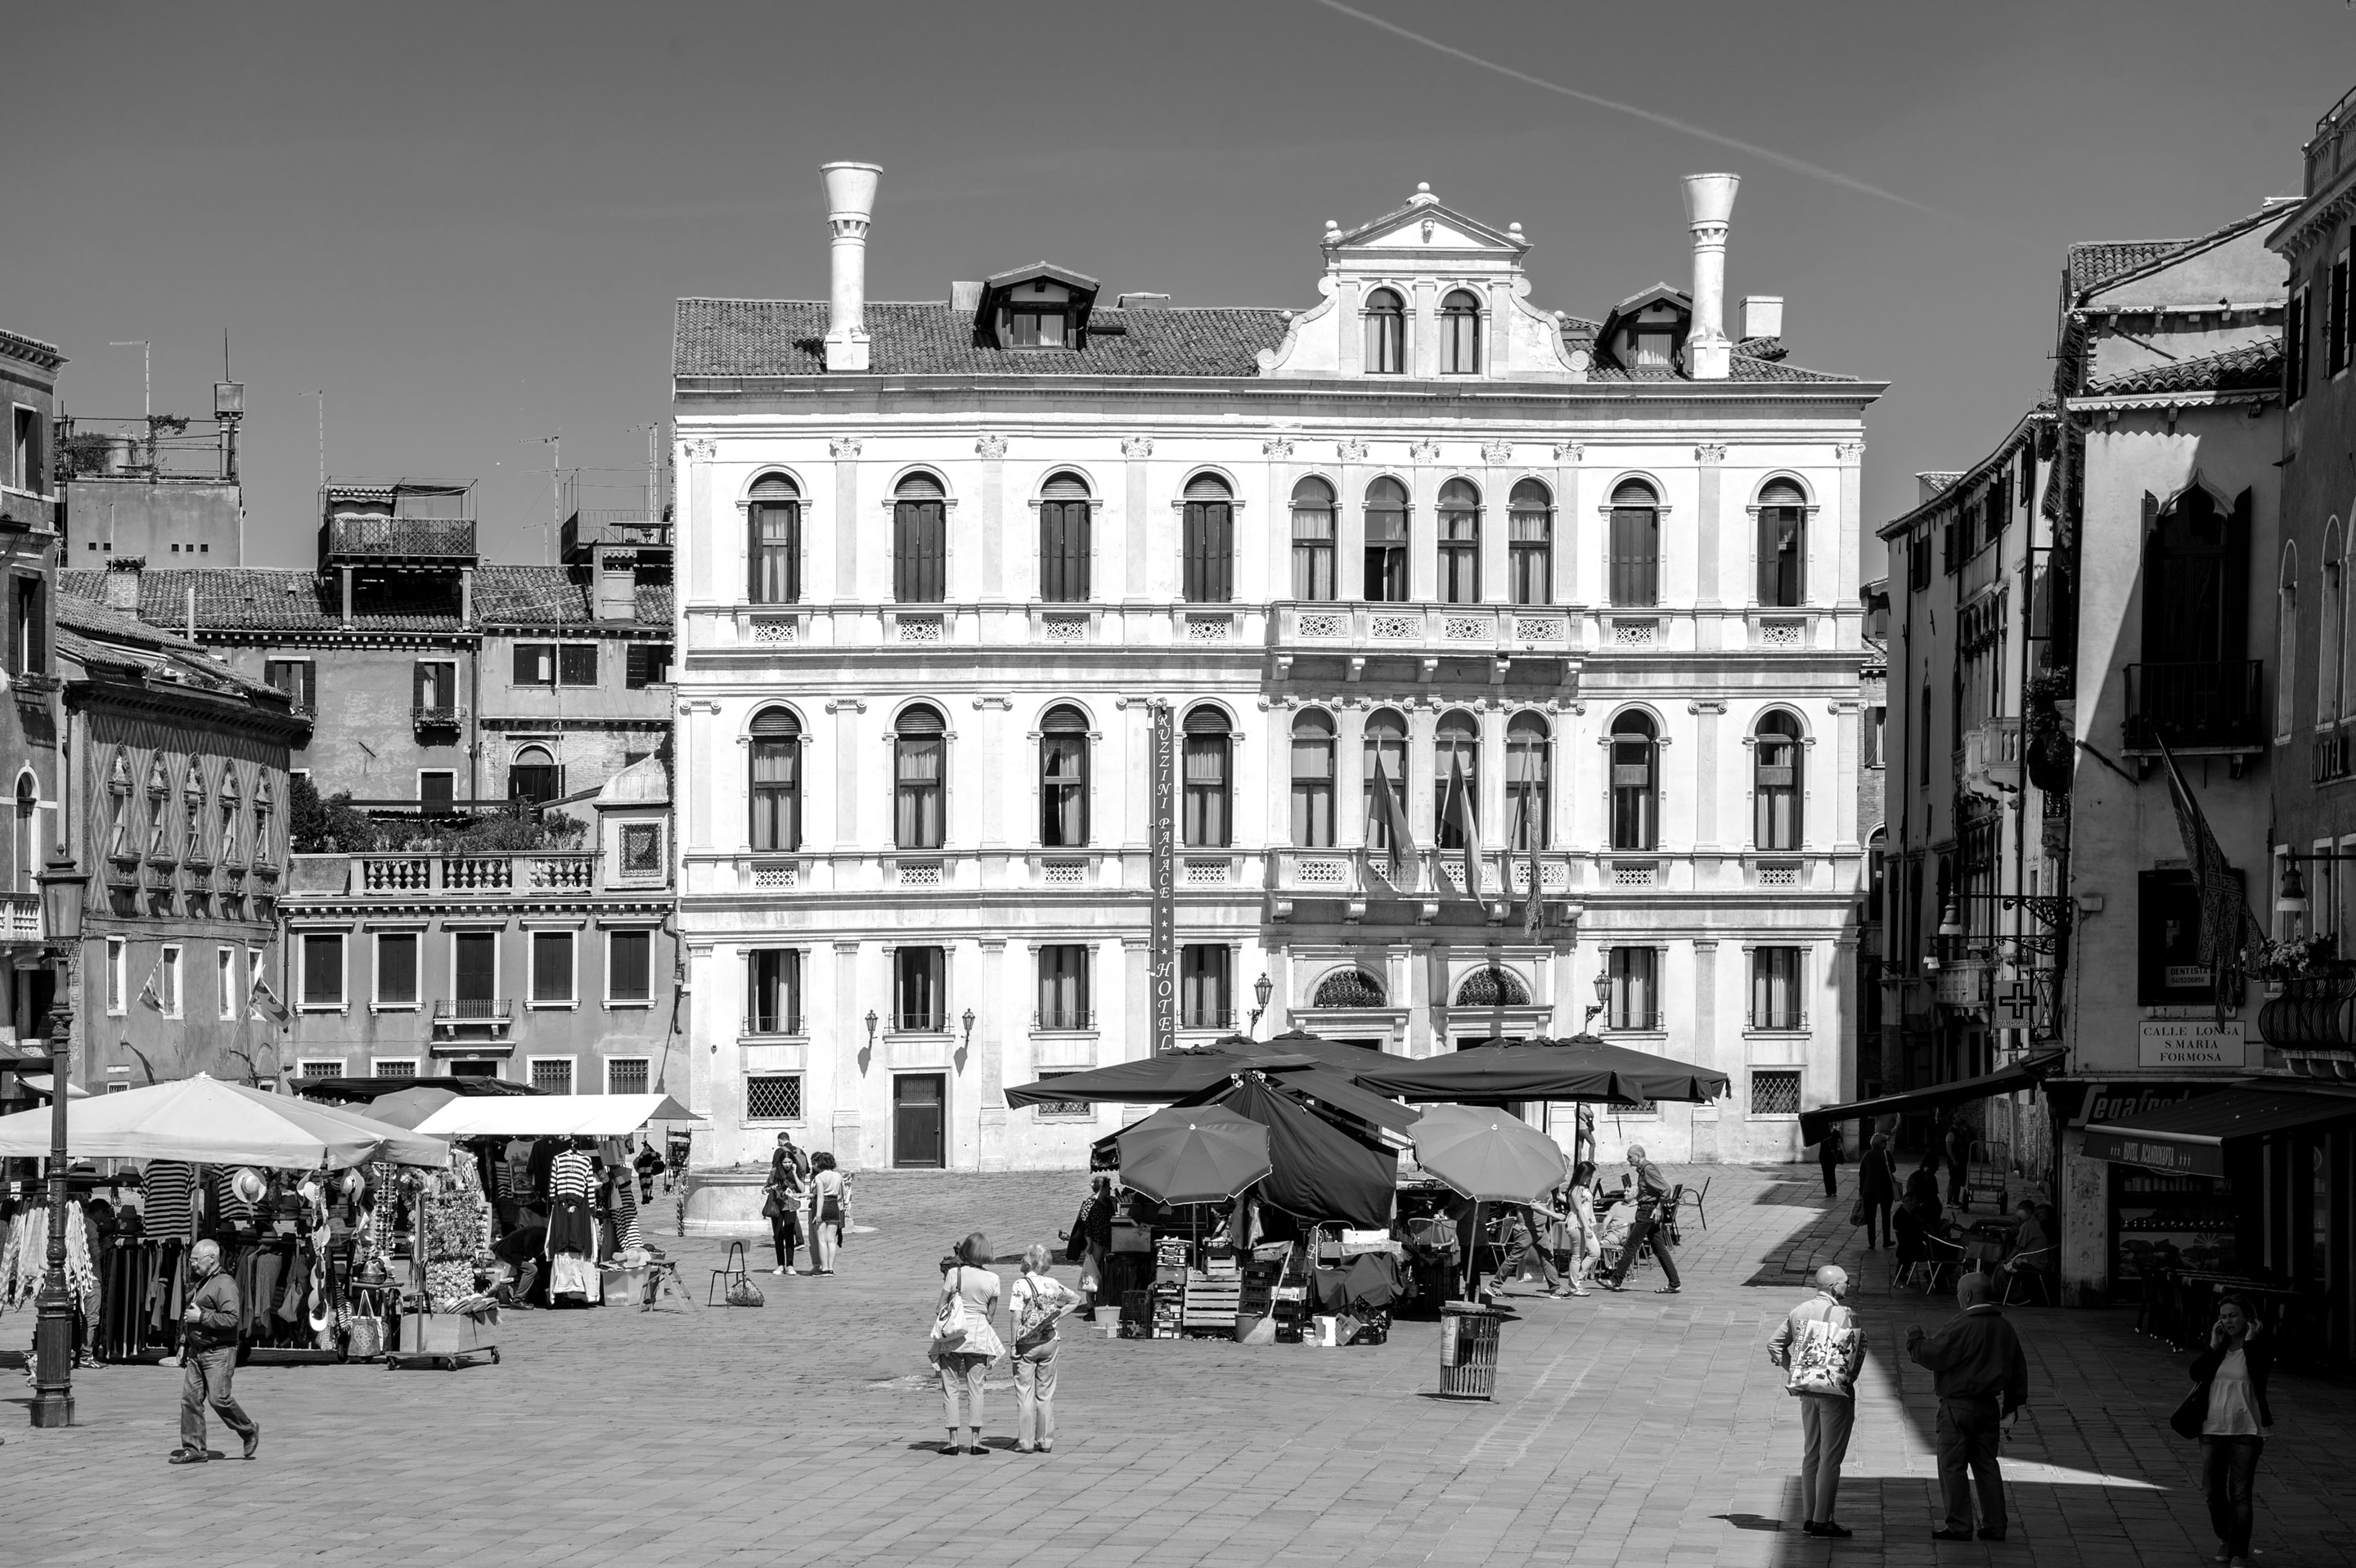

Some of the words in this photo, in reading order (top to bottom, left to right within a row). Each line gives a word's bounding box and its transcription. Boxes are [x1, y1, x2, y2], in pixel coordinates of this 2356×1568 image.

[1157, 714, 1171, 810] RUZZINI
[2310, 737, 2344, 782] HOTEL
[1158, 817, 1171, 899] PALACE
[2170, 967, 2208, 976] DENTISTA
[1156, 962, 1173, 1052] HOTEL
[1998, 1019, 2038, 1028] FARMACA
[2143, 1027, 2187, 1036] CALLE
[2196, 1027, 2239, 1036] LONGA
[2165, 1040, 2219, 1049] S.MARIA
[2160, 1052, 2222, 1063] FORMOSA
[2123, 1141, 2138, 1161] HOTEL
